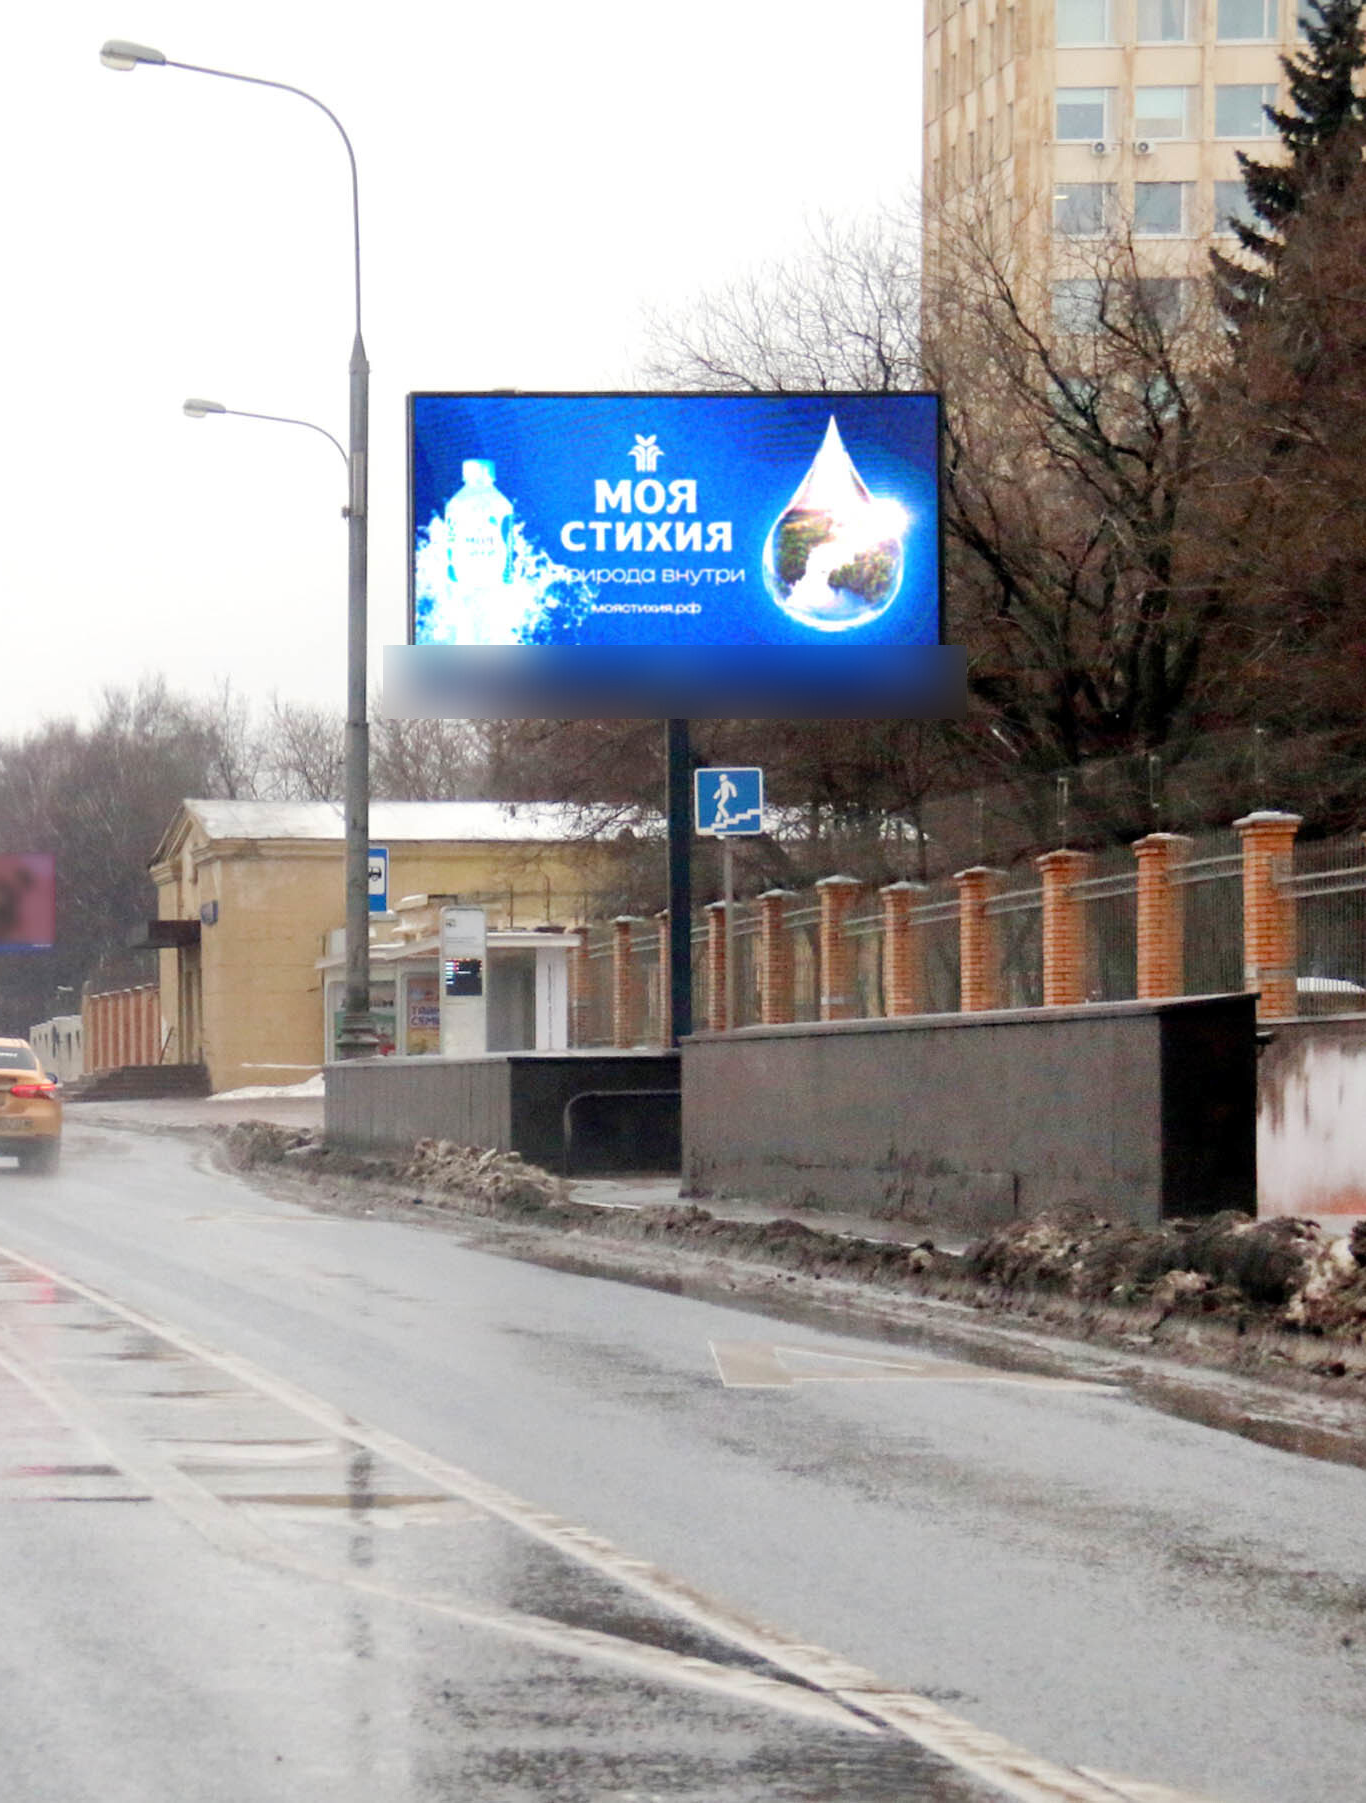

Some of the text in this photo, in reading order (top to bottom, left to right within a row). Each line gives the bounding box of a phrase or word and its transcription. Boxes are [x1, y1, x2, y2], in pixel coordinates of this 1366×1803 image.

[594, 478, 697, 514] МОЯ
[560, 521, 733, 552] СТИХИЯ
[555, 567, 746, 586] рирода внутри
[591, 601, 702, 615] моястихия.рф
